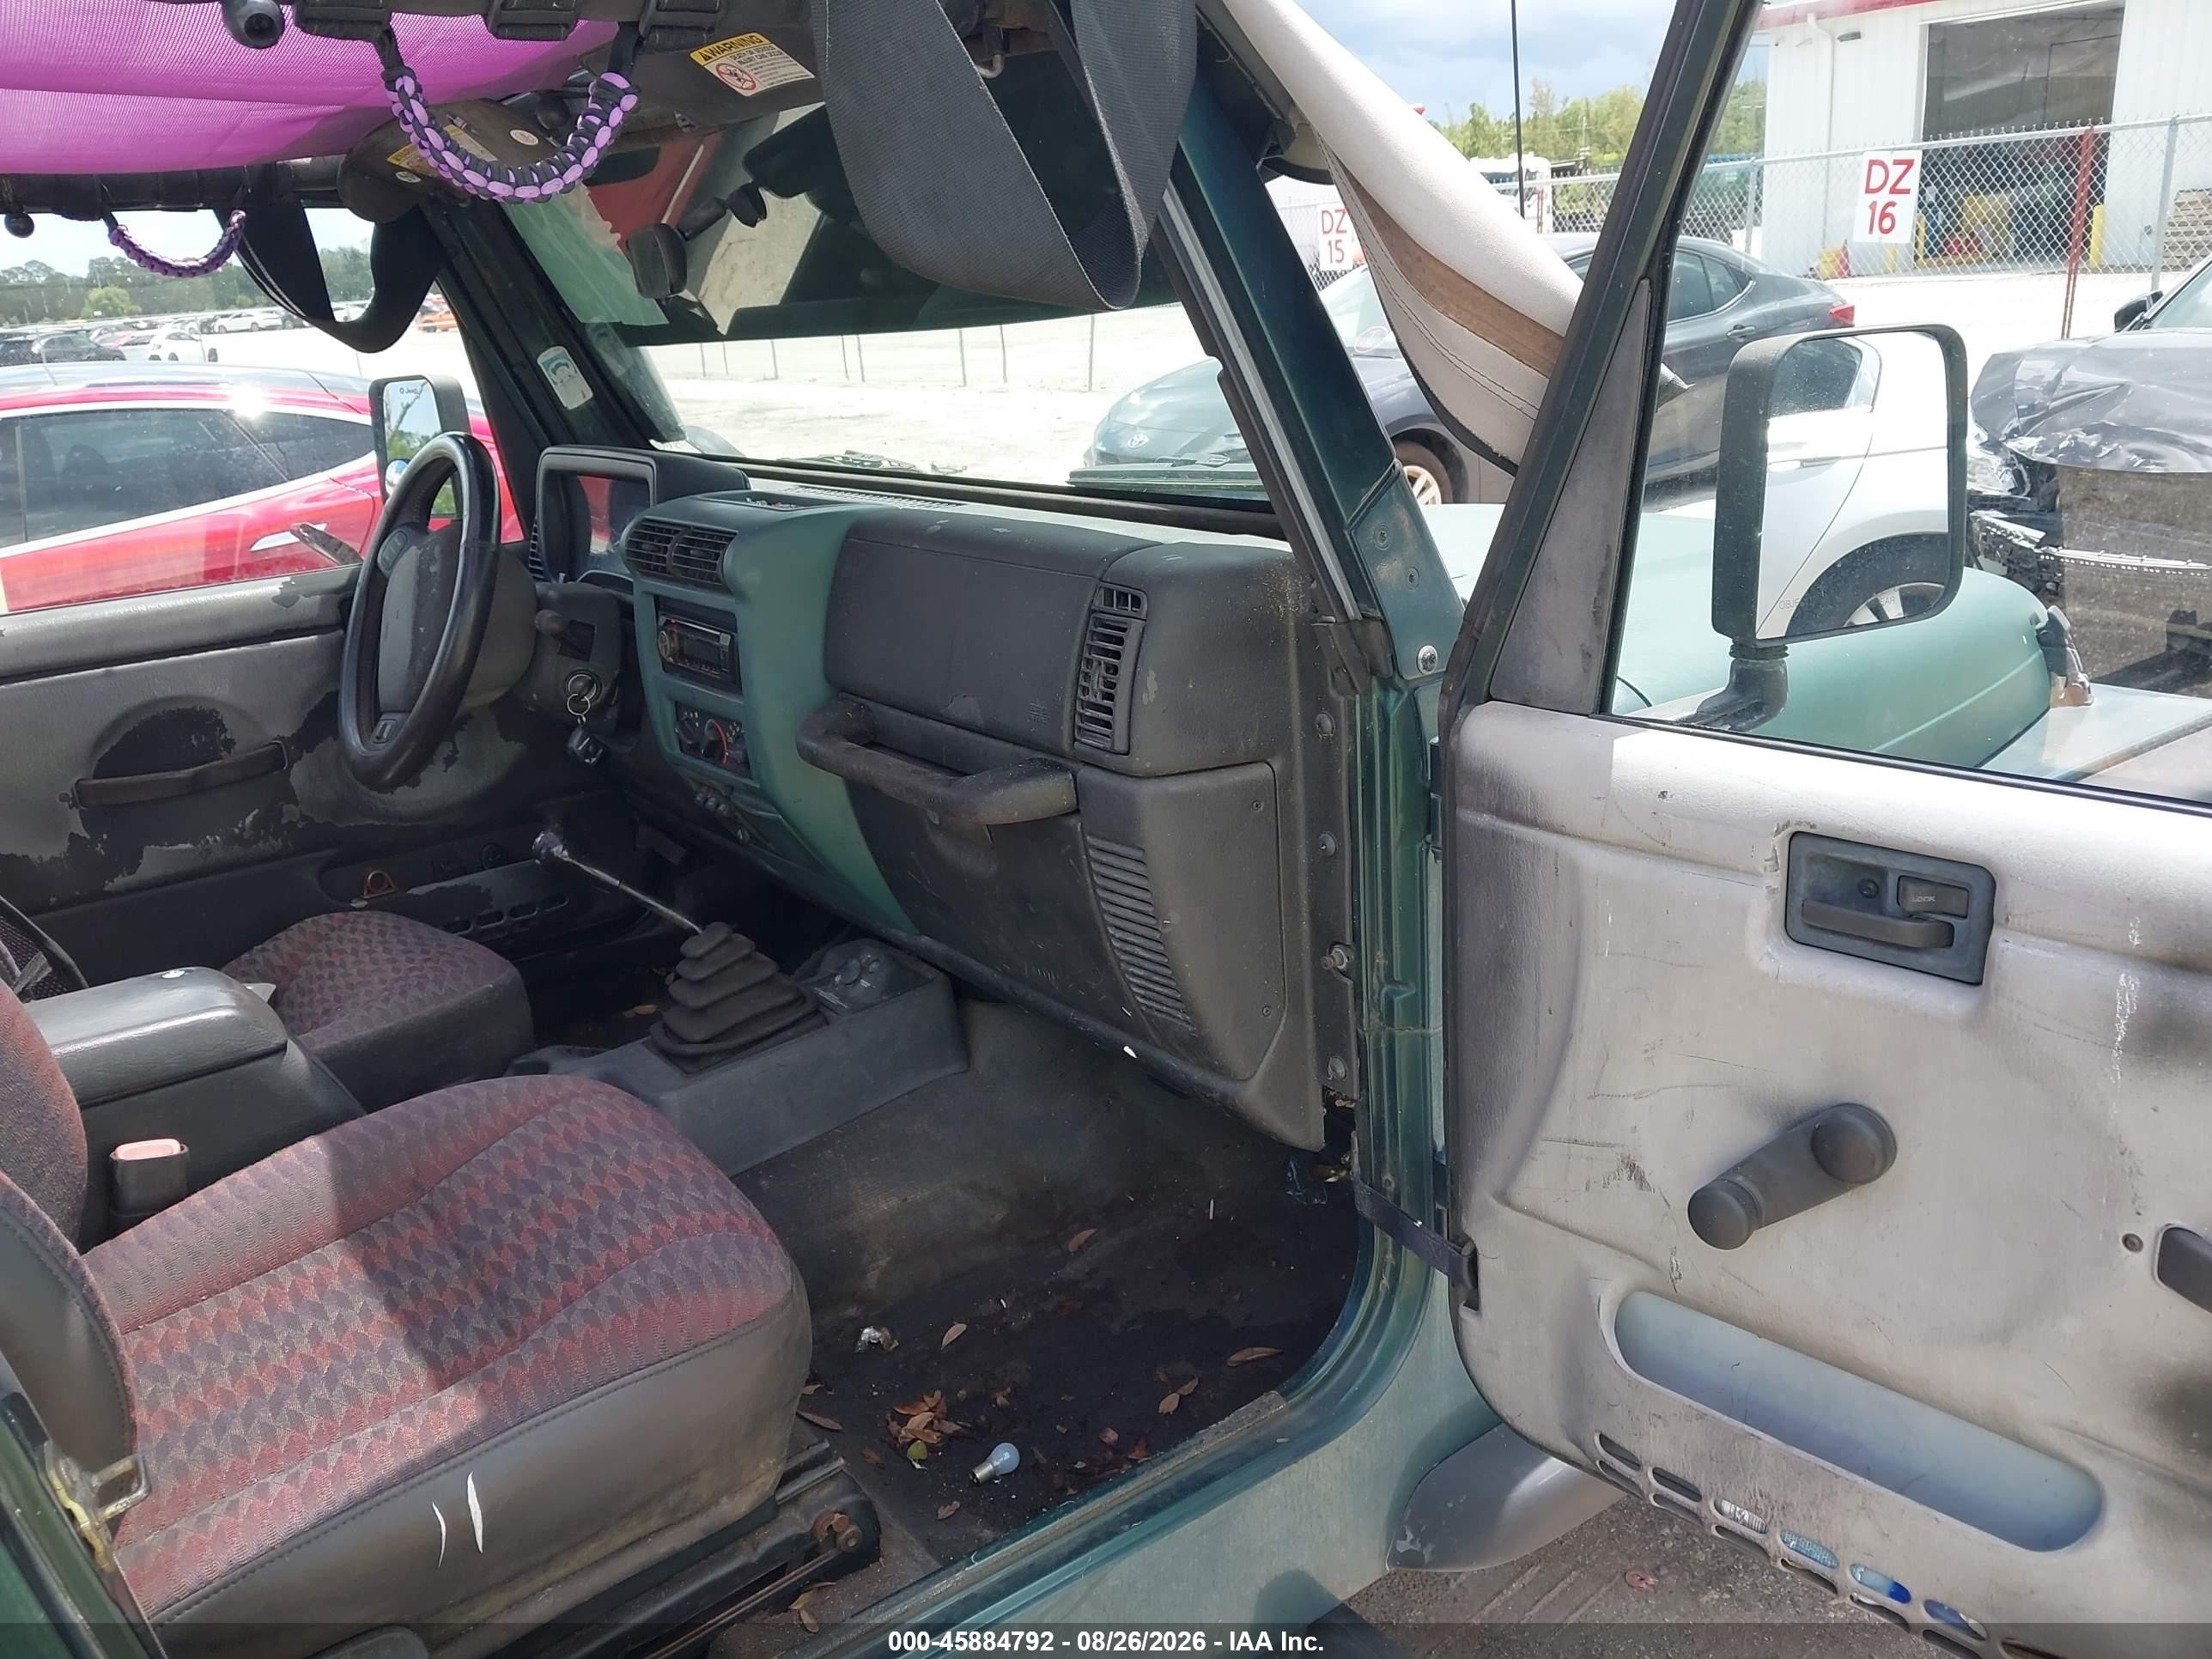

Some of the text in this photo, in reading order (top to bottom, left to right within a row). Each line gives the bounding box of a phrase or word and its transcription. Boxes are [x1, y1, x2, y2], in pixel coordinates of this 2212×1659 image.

[706, 34, 763, 59] WARNING
[1864, 158, 1916, 195] DZ
[1321, 208, 1347, 234] DZ
[1868, 200, 1898, 234] 16
[1328, 239, 1345, 264] 15
